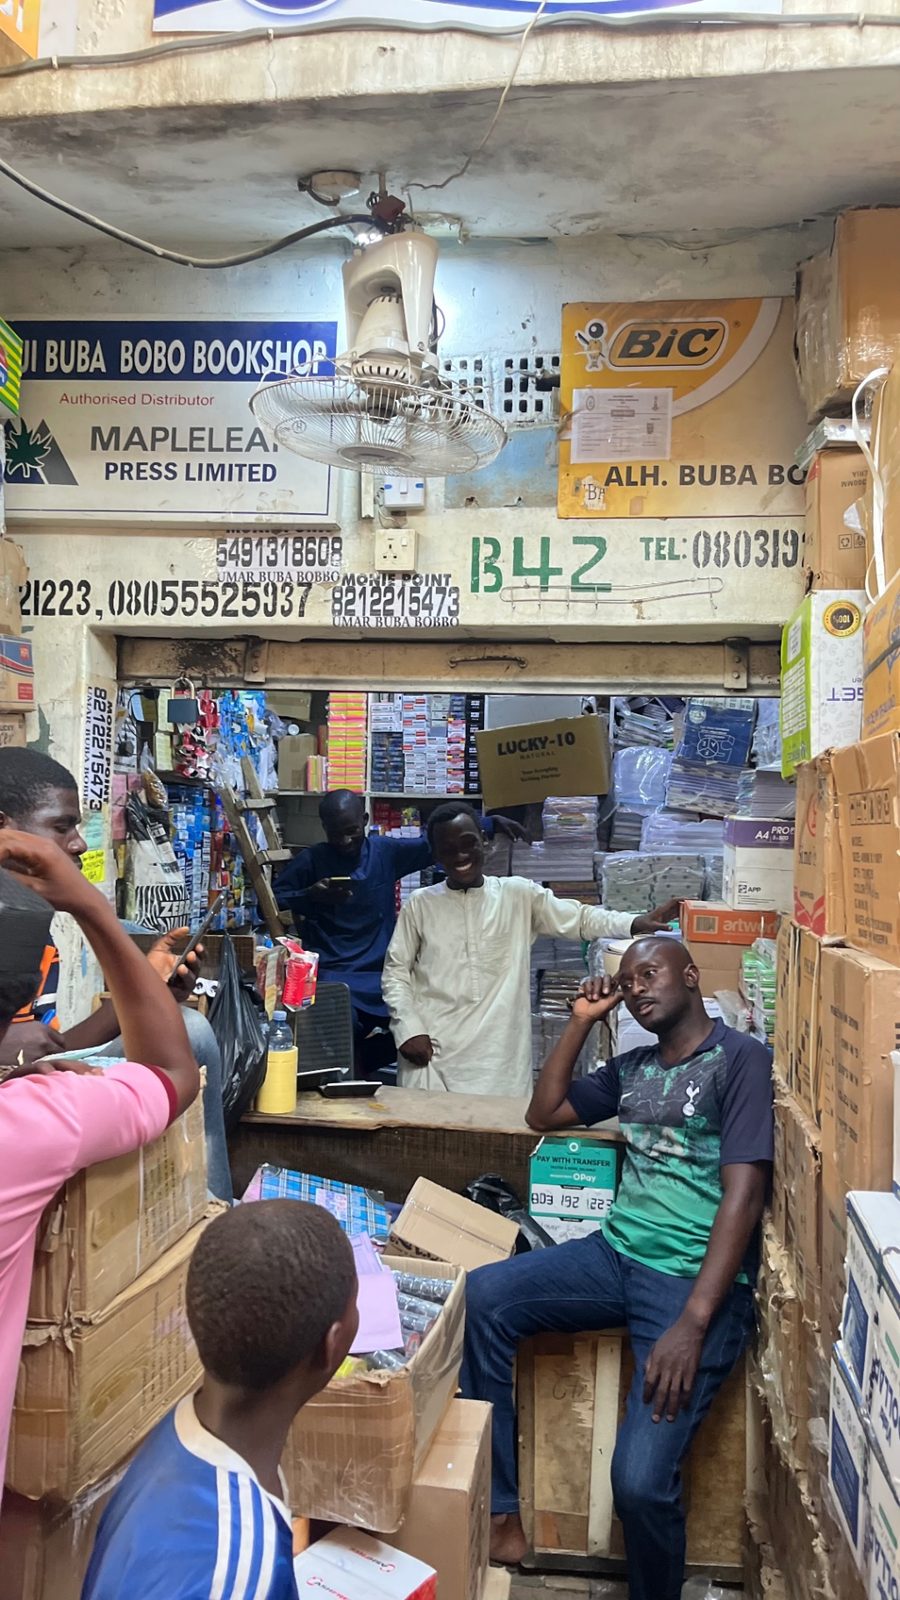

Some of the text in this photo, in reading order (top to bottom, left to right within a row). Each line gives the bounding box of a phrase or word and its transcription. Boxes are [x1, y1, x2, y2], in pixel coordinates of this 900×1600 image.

[46, 340, 107, 374] BUBA
[120, 339, 186, 375] BOBO
[193, 339, 327, 376] BOOKSHOP
[59, 393, 215, 406] Authorised Distributor
[91, 426, 279, 453] MAPLELEA
[105, 462, 278, 483] PRESS LIMITED
[604, 465, 668, 487] ALH.
[679, 465, 758, 486] BUBA
[216, 536, 343, 567] 5491318608
[640, 529, 805, 568] TEL: 080319
[217, 571, 340, 583] UMAR BUBA BOBBO
[470, 536, 613, 594] B42
[341, 573, 452, 587] MONIE POINT
[331, 586, 460, 617] 8212215473
[332, 616, 460, 628] UMAR BUBA BOBBO
[85, 686, 93, 724] UMAR
[84, 729, 92, 764] BUBA
[89, 686, 107, 813] 8212215473
[103, 701, 113, 804] MONIE POINT
[497, 732, 576, 756] LUCKY-10
[755, 826, 790, 840] A4 PRO
[537, 1155, 610, 1167] PAY WITH TRANSFER
[531, 1192, 553, 1206] 803
[561, 1194, 579, 1208] 192
